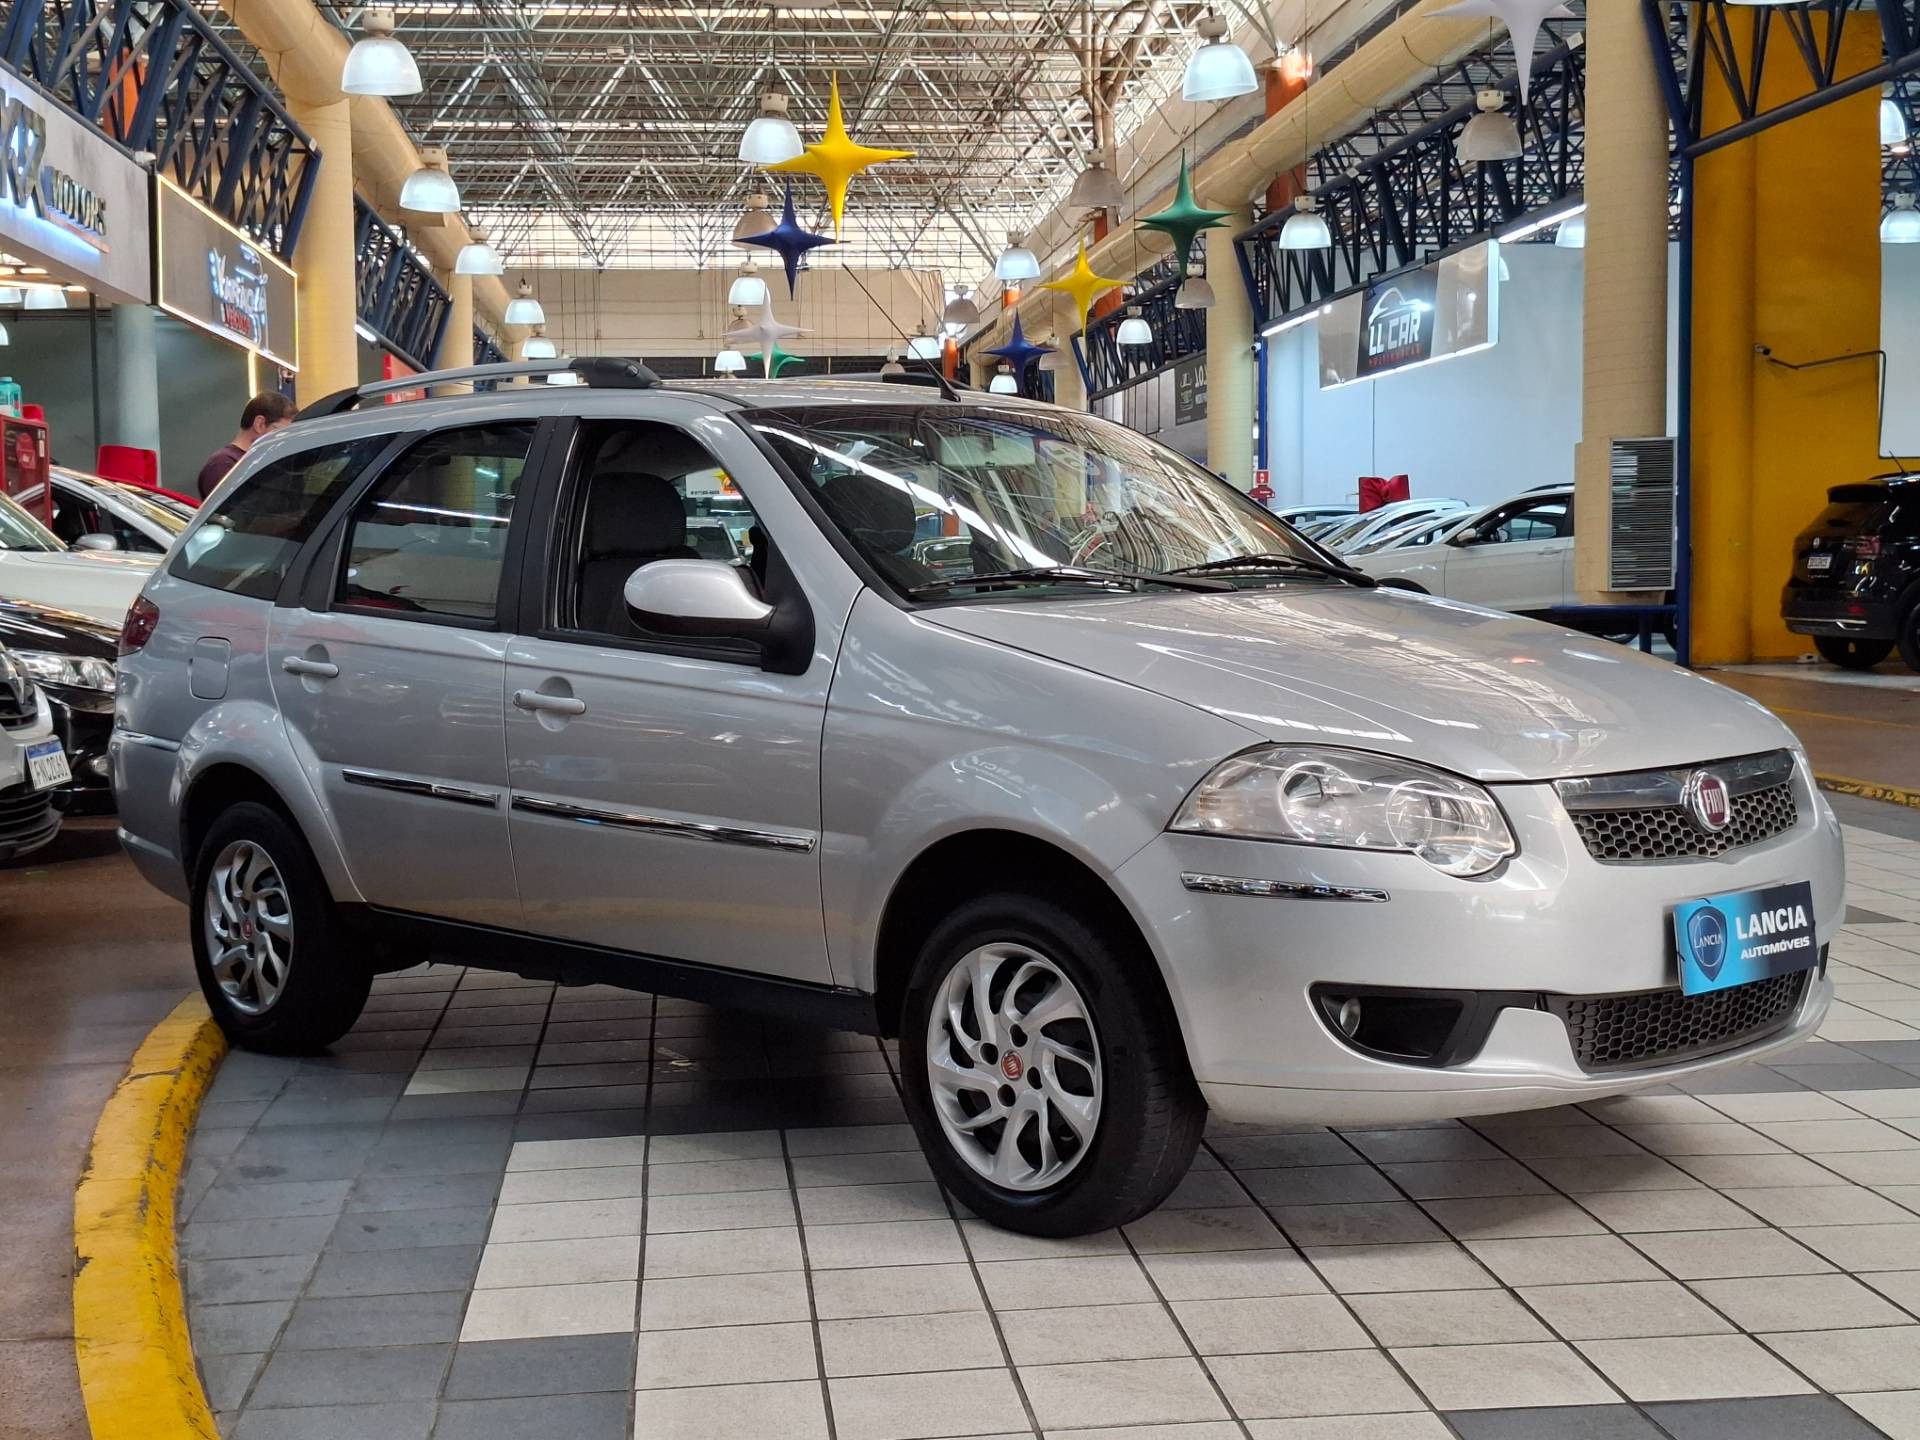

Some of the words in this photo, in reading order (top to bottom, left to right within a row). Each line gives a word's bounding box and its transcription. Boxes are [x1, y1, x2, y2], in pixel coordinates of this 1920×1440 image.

[46, 166, 106, 236] MOTORS
[1368, 322, 1385, 357] LL
[1387, 311, 1421, 349] CAR
[1702, 787, 1724, 815] FIAT
[1735, 904, 1808, 940] LANCIA
[1693, 934, 1723, 949] LANCIA
[1740, 935, 1810, 960] AUTOMÓVEIS
